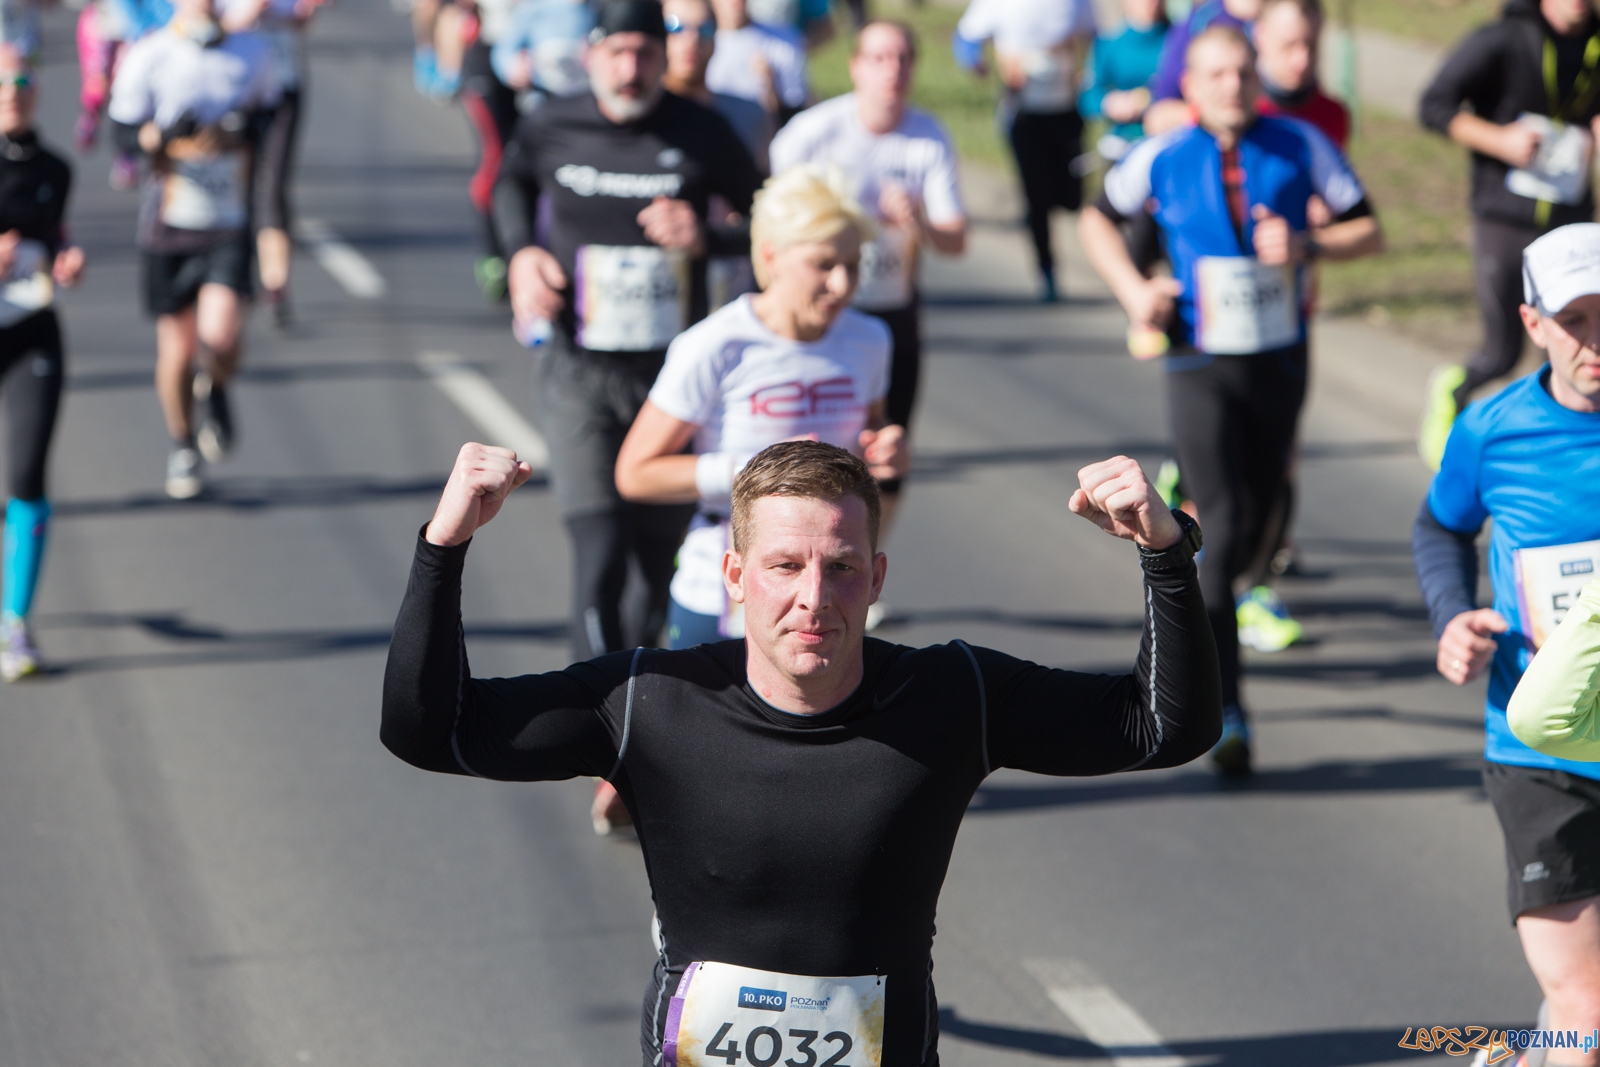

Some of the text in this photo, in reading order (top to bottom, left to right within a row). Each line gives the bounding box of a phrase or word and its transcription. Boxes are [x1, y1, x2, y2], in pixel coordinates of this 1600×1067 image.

[743, 992, 783, 1006] 10. PKO
[705, 1022, 853, 1067] 4032
